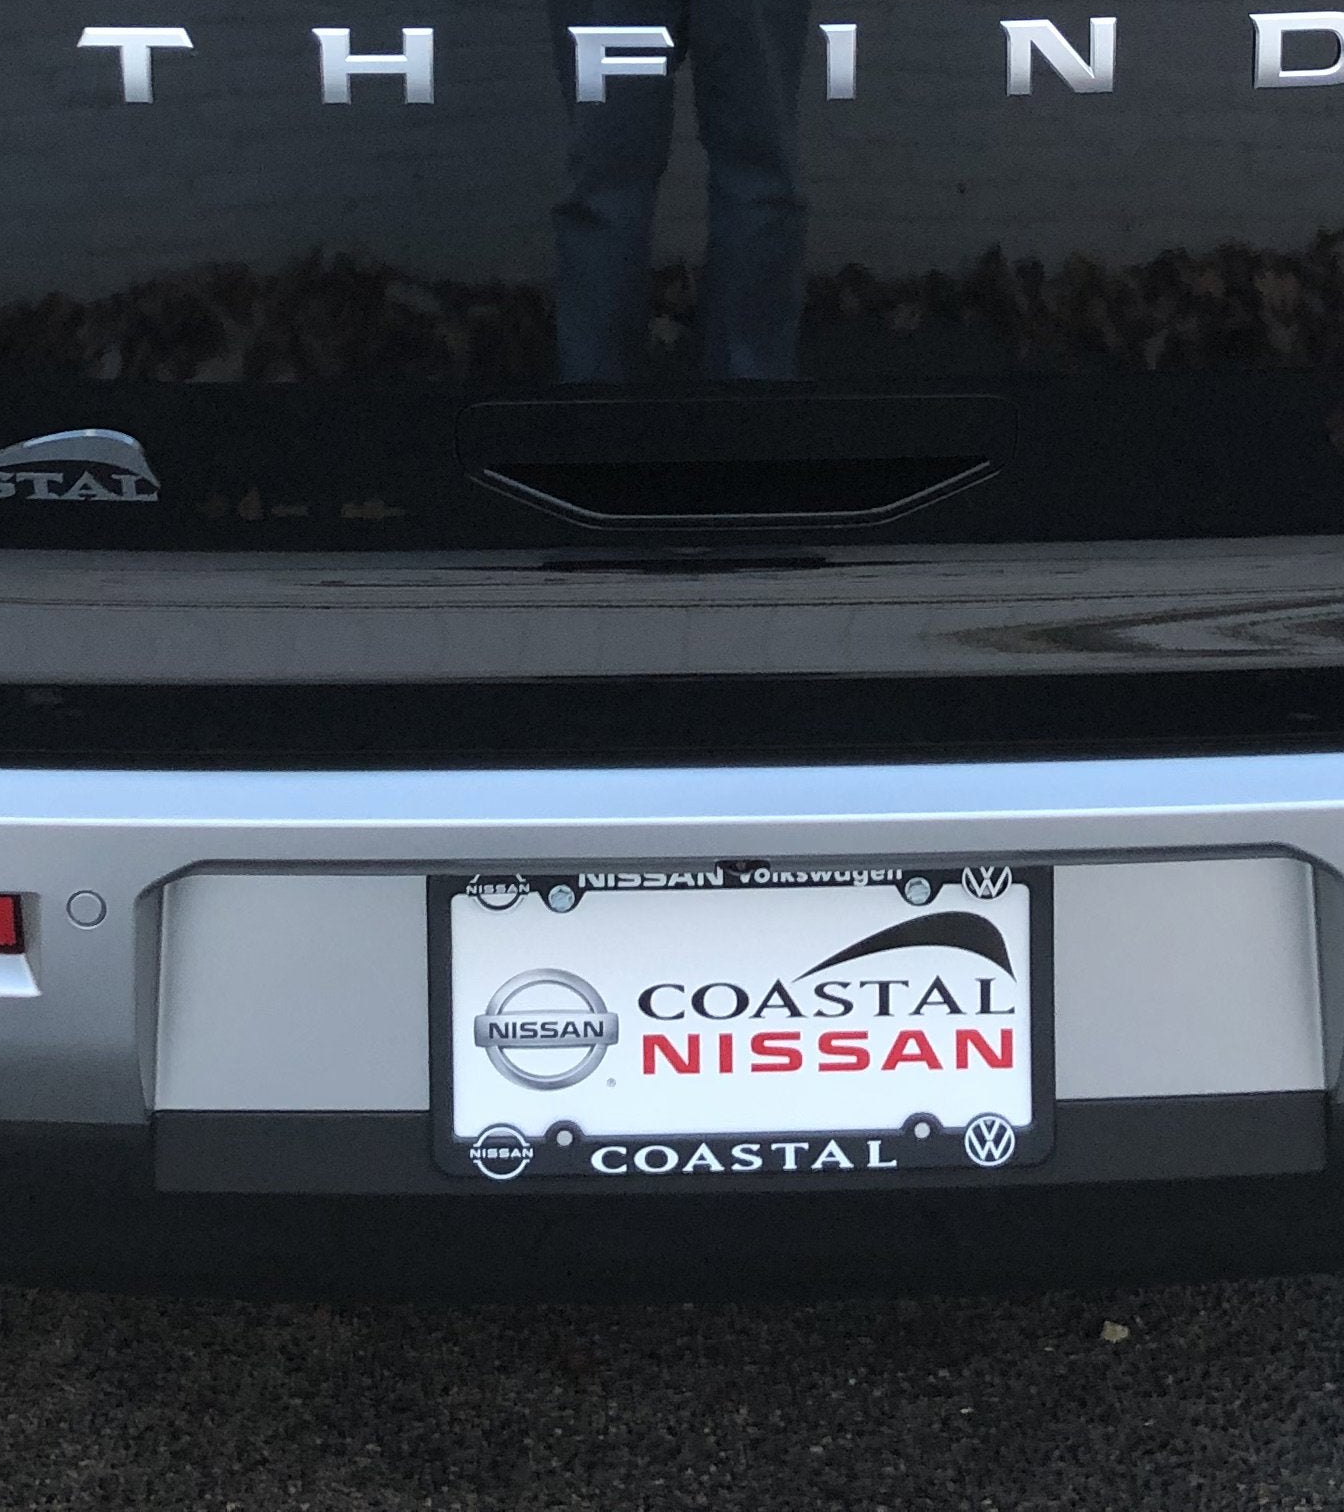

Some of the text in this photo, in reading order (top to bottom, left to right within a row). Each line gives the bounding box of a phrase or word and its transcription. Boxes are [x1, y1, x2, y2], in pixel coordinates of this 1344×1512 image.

[466, 882, 530, 895] NISSAN
[578, 870, 724, 888] NISSAN
[637, 974, 1016, 1020] COASTAL
[488, 1020, 604, 1039] NISSAN
[642, 1028, 1014, 1074] NISSAN
[469, 1147, 534, 1159] NISSAN
[590, 1139, 898, 1174] COASTAL
